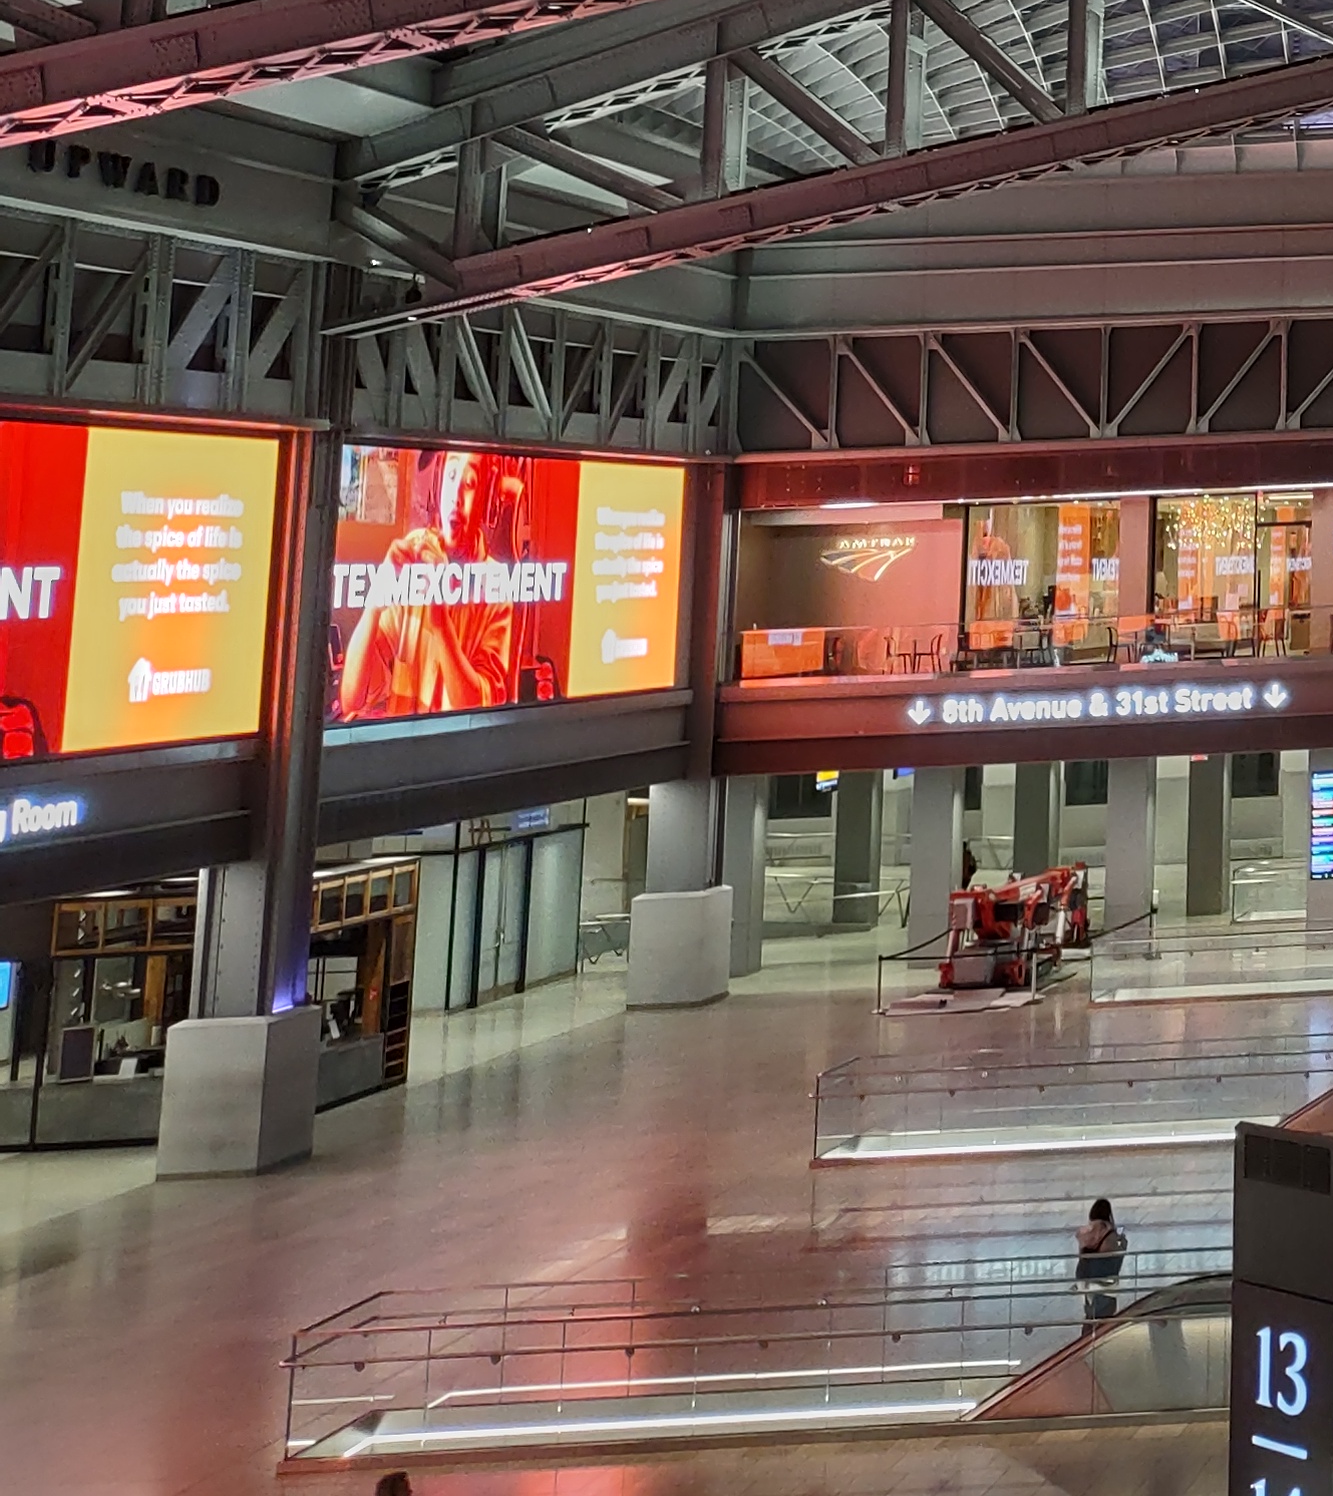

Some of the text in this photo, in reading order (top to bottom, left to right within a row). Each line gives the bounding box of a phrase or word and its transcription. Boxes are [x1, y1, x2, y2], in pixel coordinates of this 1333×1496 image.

[27, 139, 221, 207] UPWARD
[167, 497, 193, 520] you
[145, 525, 184, 553] spice
[186, 525, 203, 548] of
[333, 561, 567, 608] TEXMEXCITEMENT
[147, 590, 177, 620] just
[990, 696, 1083, 722] Avenue
[1089, 690, 1108, 717] &
[1115, 690, 1169, 716] 31st
[1174, 687, 1253, 713] Street
[12, 799, 78, 835] Room
[1256, 1326, 1307, 1416] 13
